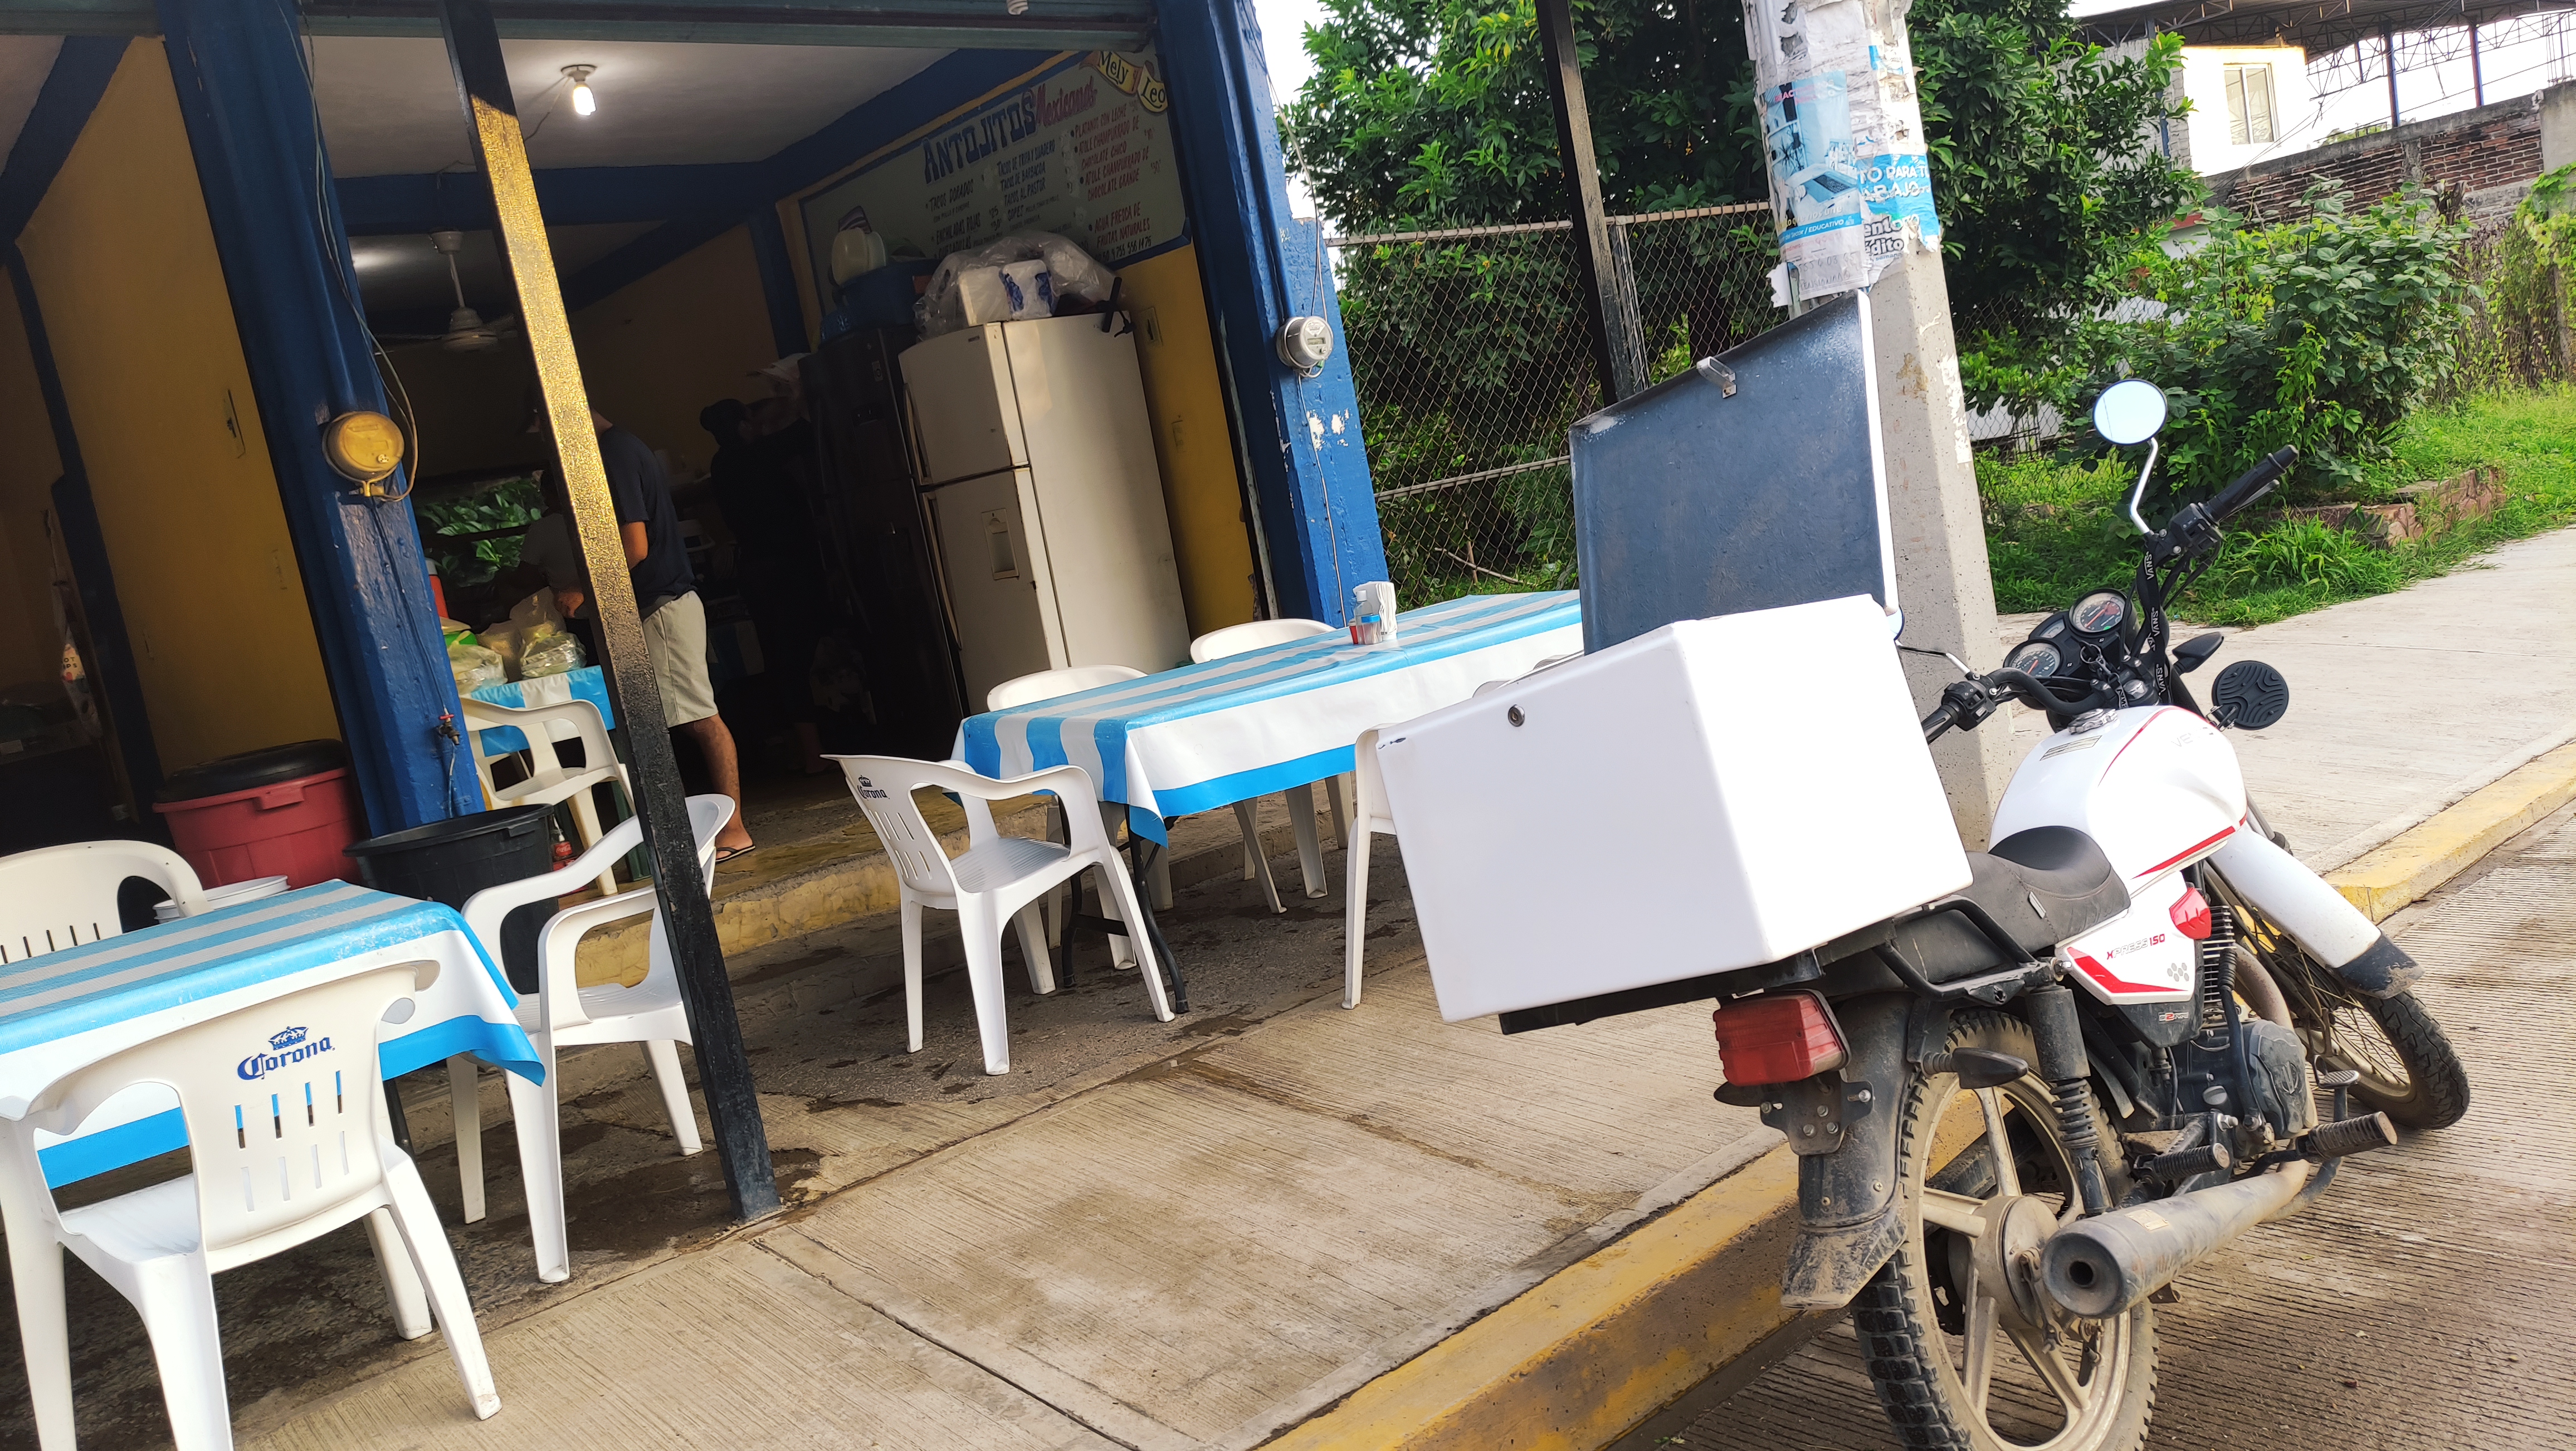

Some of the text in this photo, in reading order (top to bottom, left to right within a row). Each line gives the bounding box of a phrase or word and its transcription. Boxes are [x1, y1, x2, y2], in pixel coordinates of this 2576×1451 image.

[1098, 51, 1129, 85] Mely
[1140, 77, 1165, 109] Leo
[923, 87, 1037, 184] ANTOJITOS
[1075, 116, 1099, 138] PLATANOS
[1100, 113, 1110, 126] CON
[1111, 103, 1126, 122] LECHE
[1079, 115, 1139, 155] ATOLE CHAMPURRADO DE
[997, 160, 1011, 177] TACOS
[1012, 156, 1018, 171] DE
[1035, 139, 1055, 160] SUADERO
[1081, 148, 1108, 170] CHOCOLATE
[1085, 168, 1100, 185] ATOLE
[1103, 150, 1141, 178] CHAMPURRADO
[1143, 145, 1149, 160] DE
[1886, 165, 1918, 181] PARA
[1001, 176, 1014, 191] TACOS
[1015, 172, 1021, 185] DE
[1022, 161, 1046, 182] BARBACOA
[1088, 177, 1117, 201] CHOCOLATE
[1119, 168, 1140, 188] GRANDE
[929, 178, 974, 212] TACOS DORADOS
[1004, 177, 1046, 207] TACOS AL PASTOR
[1007, 204, 1024, 222] SOPES
[1095, 215, 1109, 233] AGUA
[1111, 205, 1132, 227] FRESCA
[1133, 201, 1140, 217] DE
[1808, 219, 1845, 233] EDUCATIVO
[1824, 205, 1843, 216] une
[936, 219, 965, 245] ENCHILADAS
[967, 212, 980, 231] ROJAS
[1097, 230, 1118, 248] FRUTAS
[1119, 217, 1150, 240] NATURALES
[2144, 551, 2155, 580] VANS
[2150, 607, 2161, 637] VANS
[2155, 665, 2167, 696] VANS
[857, 785, 888, 801] Corona
[2106, 933, 2165, 960] XPRESS 150
[237, 1035, 334, 1080] Corona
